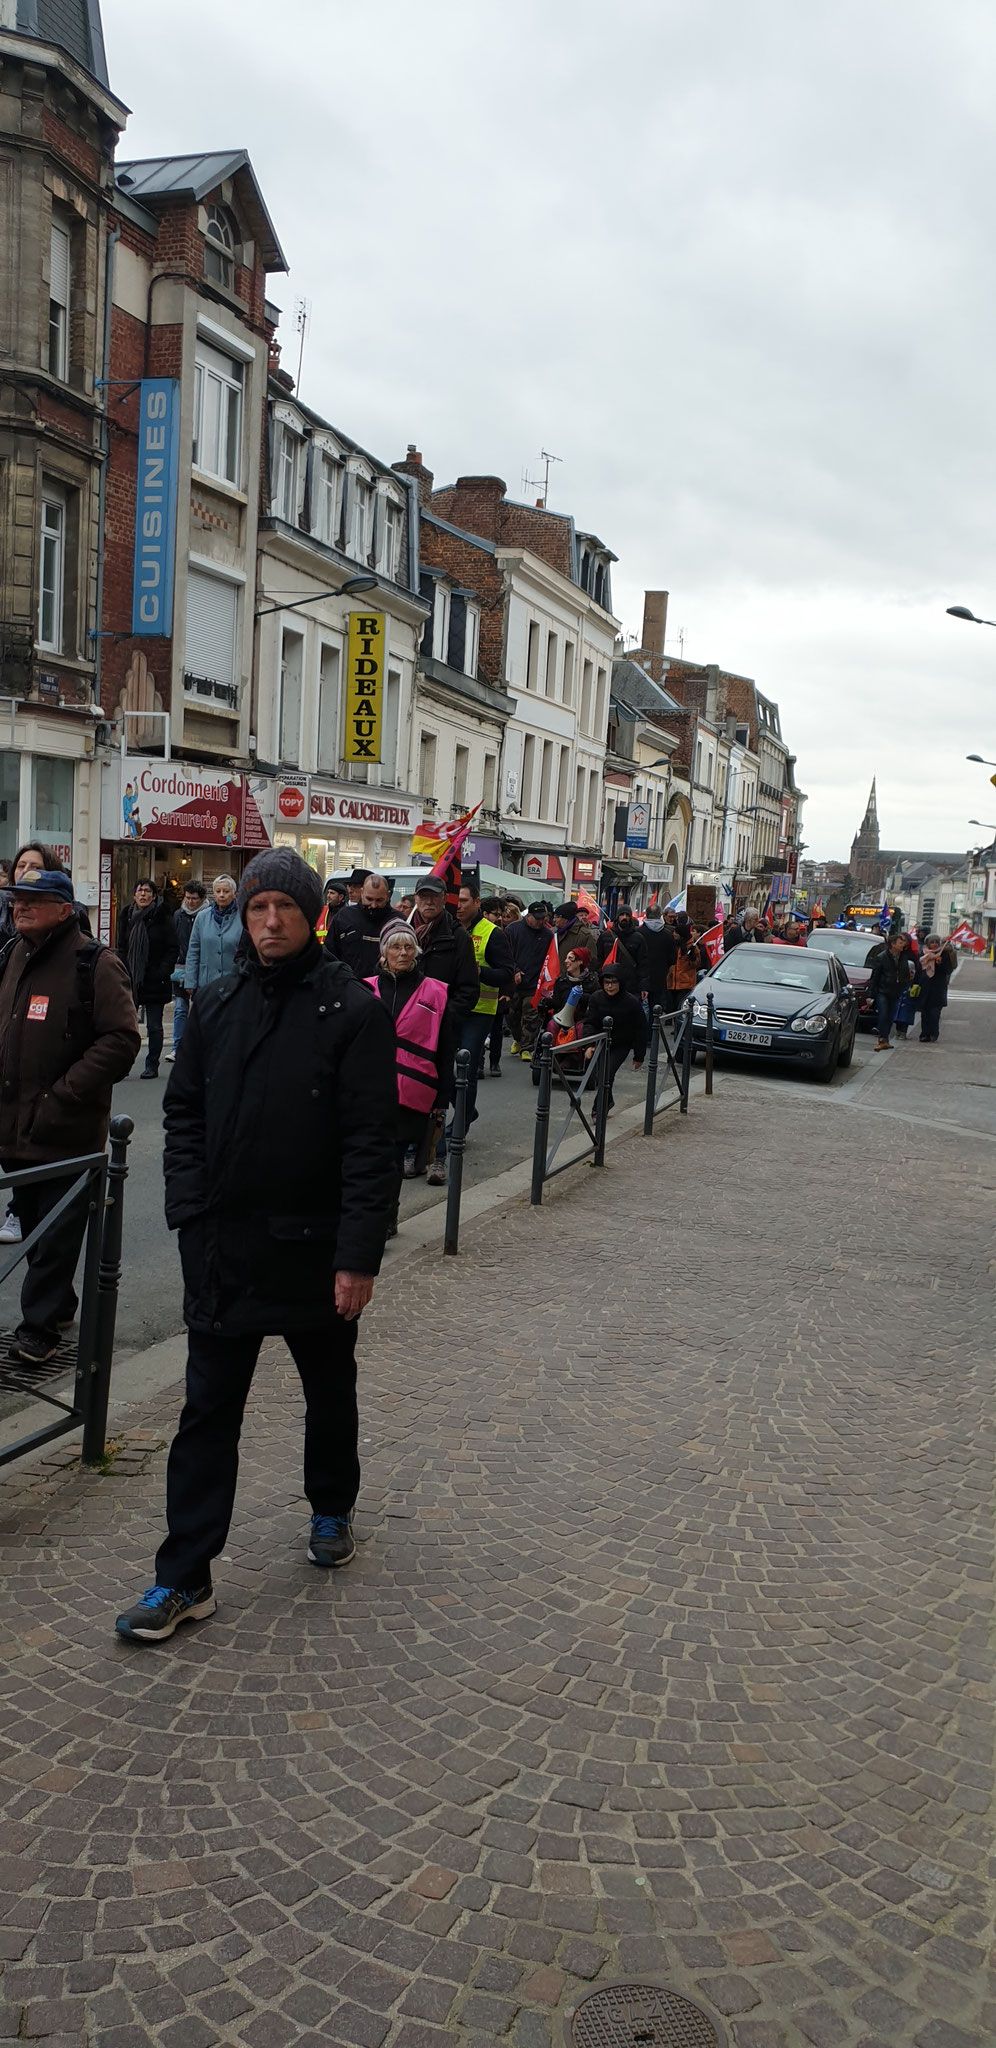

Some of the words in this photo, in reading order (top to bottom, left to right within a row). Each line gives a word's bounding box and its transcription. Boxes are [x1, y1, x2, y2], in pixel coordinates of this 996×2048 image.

[139, 391, 167, 622] CUISINES
[352, 618, 380, 757] RIDEAUX
[140, 770, 229, 802] Cordonnerie
[151, 806, 218, 829] Serrurerie
[279, 798, 303, 807] TOPY
[310, 795, 335, 816] SUS
[339, 799, 410, 826] CAUCHETEUX
[728, 1030, 747, 1041] 5262
[748, 1033, 758, 1042] YP
[759, 1035, 770, 1044] 02
